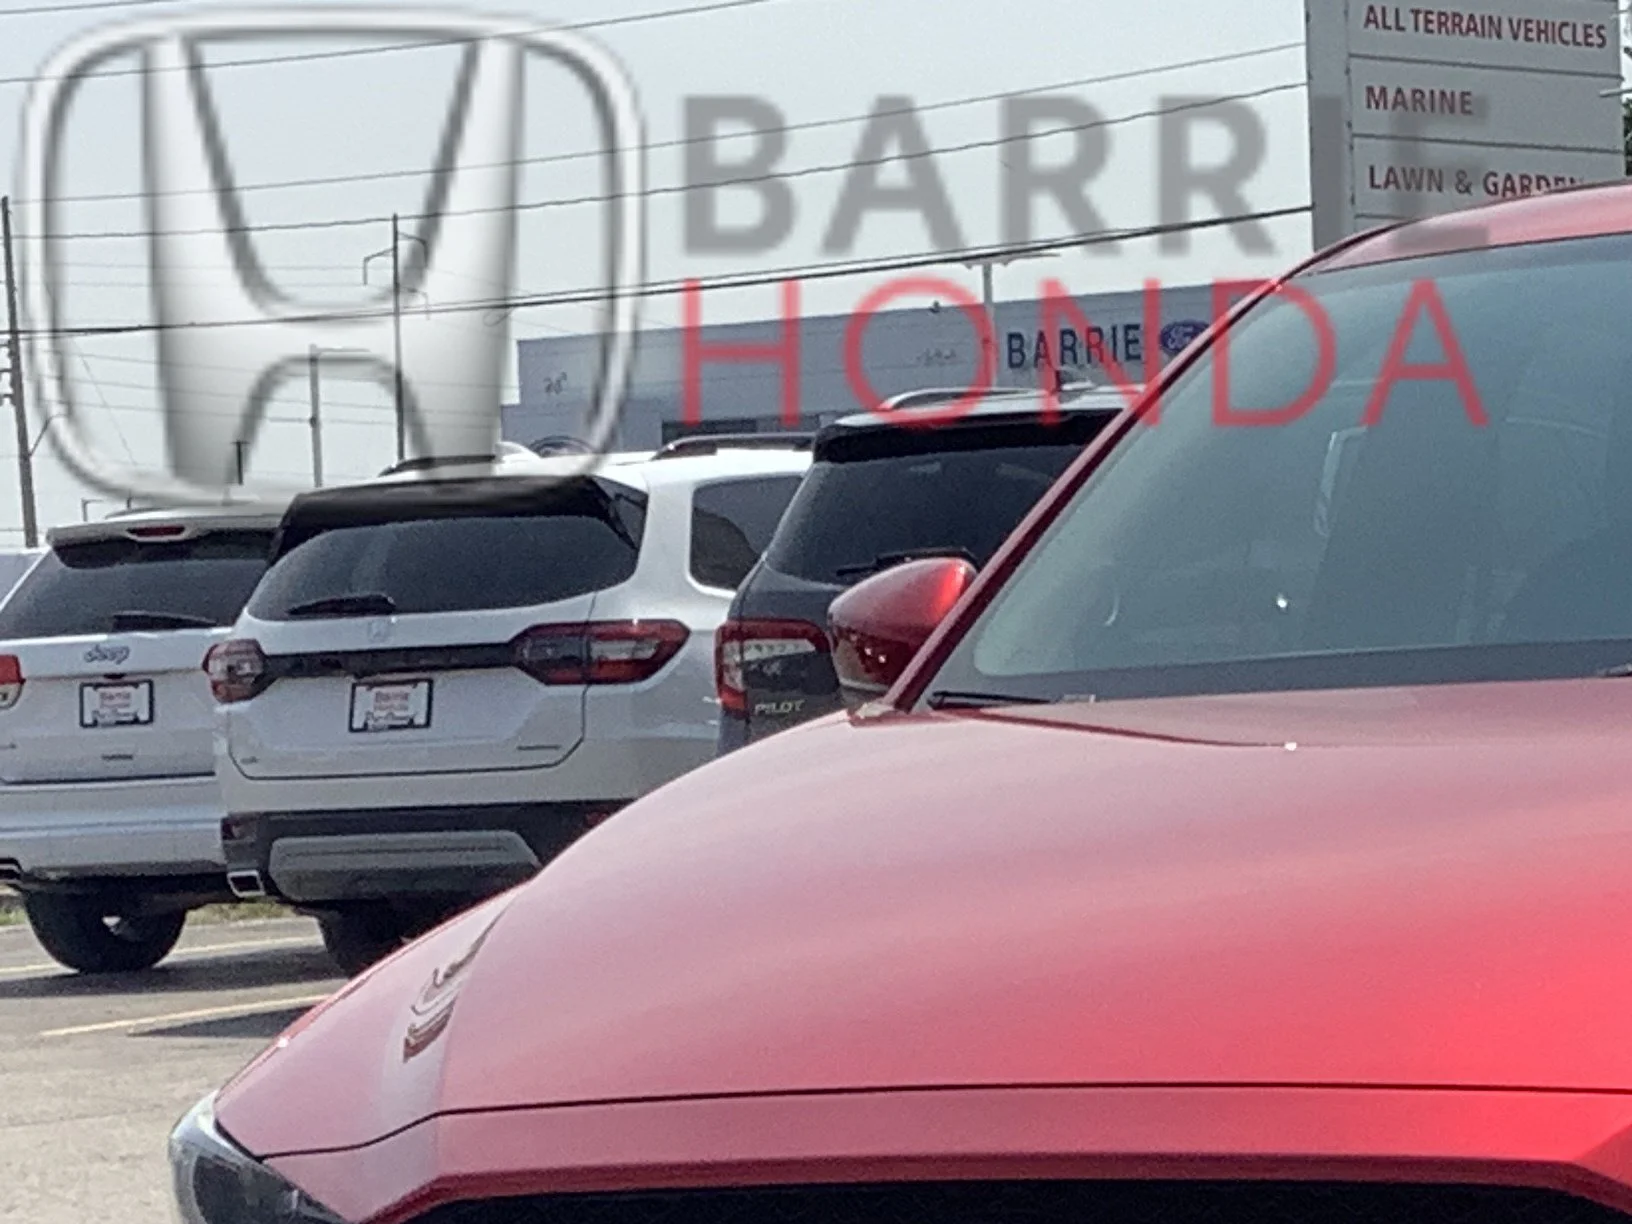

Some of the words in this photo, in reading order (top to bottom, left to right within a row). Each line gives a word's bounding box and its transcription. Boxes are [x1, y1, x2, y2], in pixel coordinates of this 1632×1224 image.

[1363, 4, 1406, 33] ALL
[1409, 8, 1502, 39] TERRAIN
[1507, 17, 1607, 48] VEHICLES
[1364, 85, 1473, 115] MARINE
[1368, 165, 1444, 193] LAWN
[1455, 169, 1473, 195] &
[1006, 323, 1143, 370] BARRIE
[754, 699, 806, 716] PILOT
